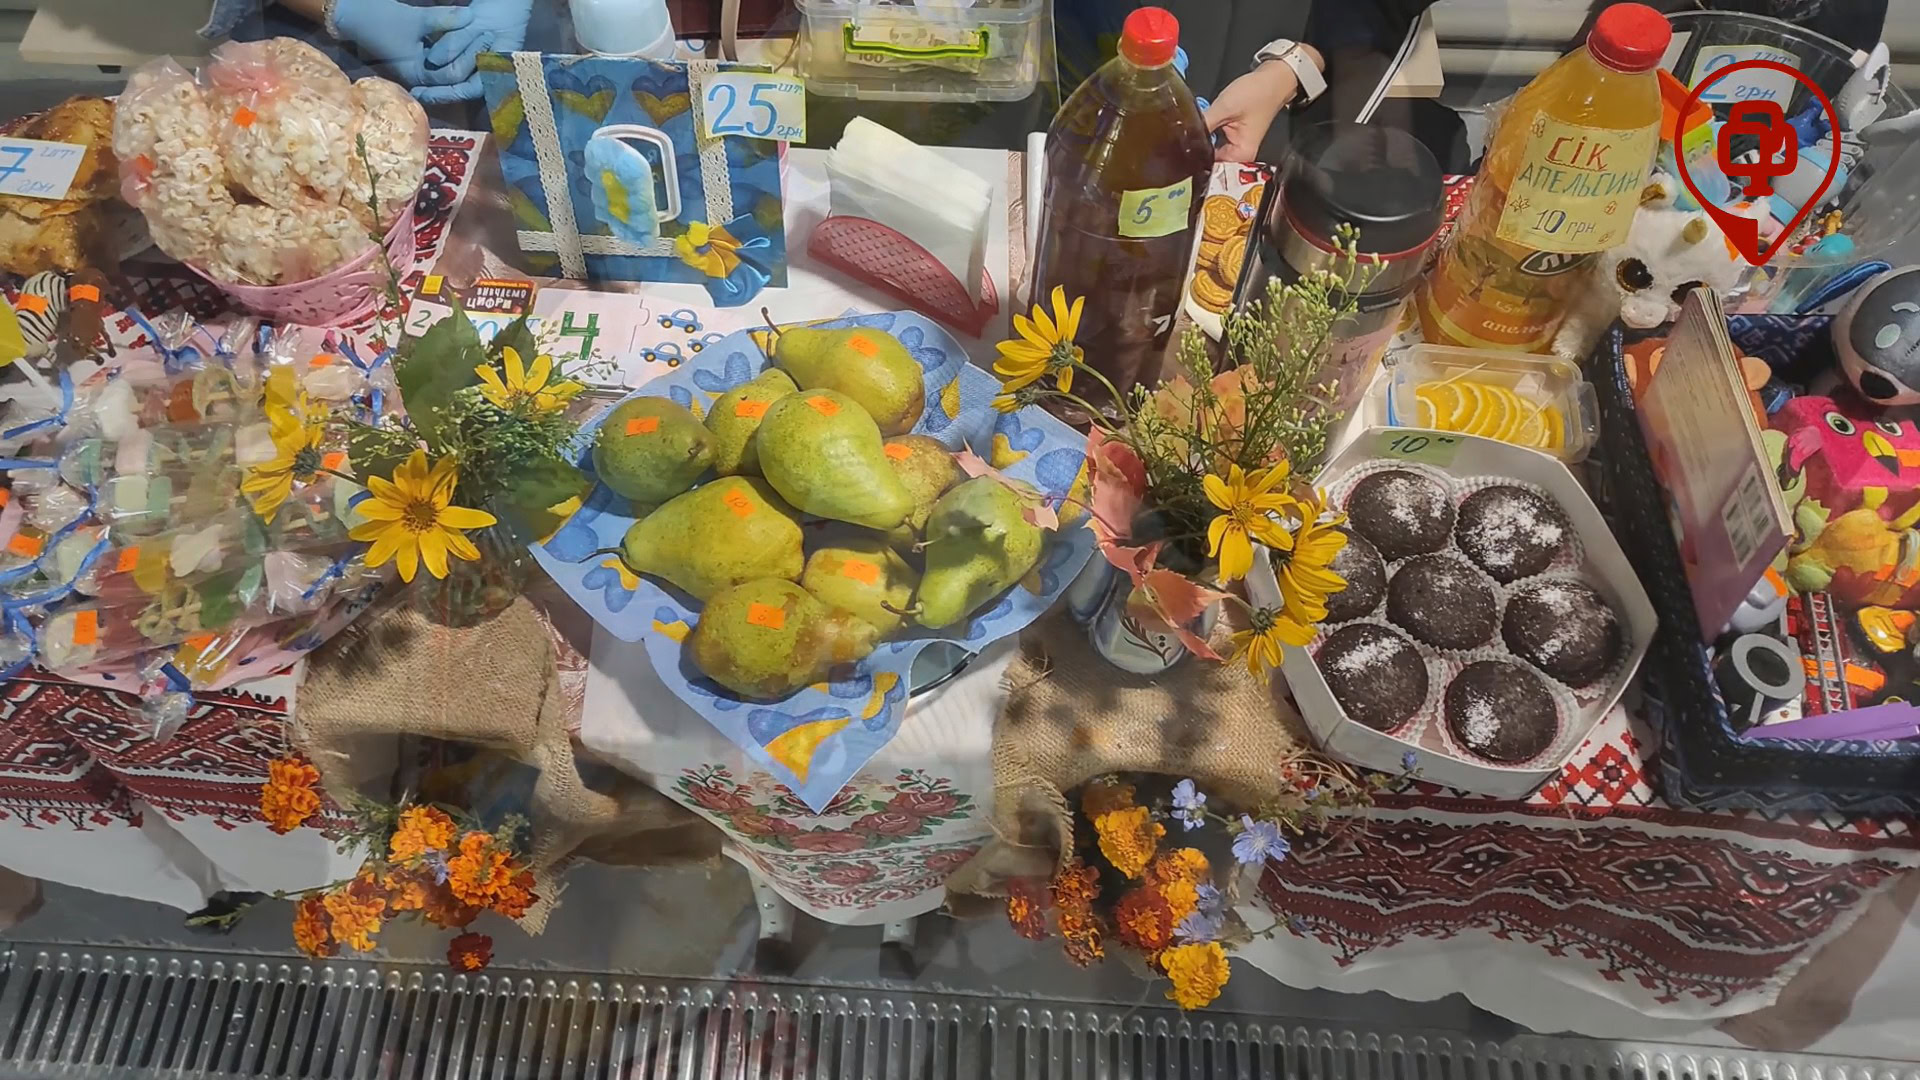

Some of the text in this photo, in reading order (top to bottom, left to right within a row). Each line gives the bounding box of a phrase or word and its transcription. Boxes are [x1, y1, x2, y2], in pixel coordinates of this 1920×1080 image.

[708, 83, 777, 136] 25
[1517, 161, 1642, 197] АПЕЛЬСИН
[1132, 195, 1158, 225] 5
[1532, 210, 1567, 234] 10
[466, 296, 513, 310] ЦИФРИ
[411, 309, 432, 329] 2
[559, 311, 601, 361] 4
[1390, 435, 1430, 454] 10
